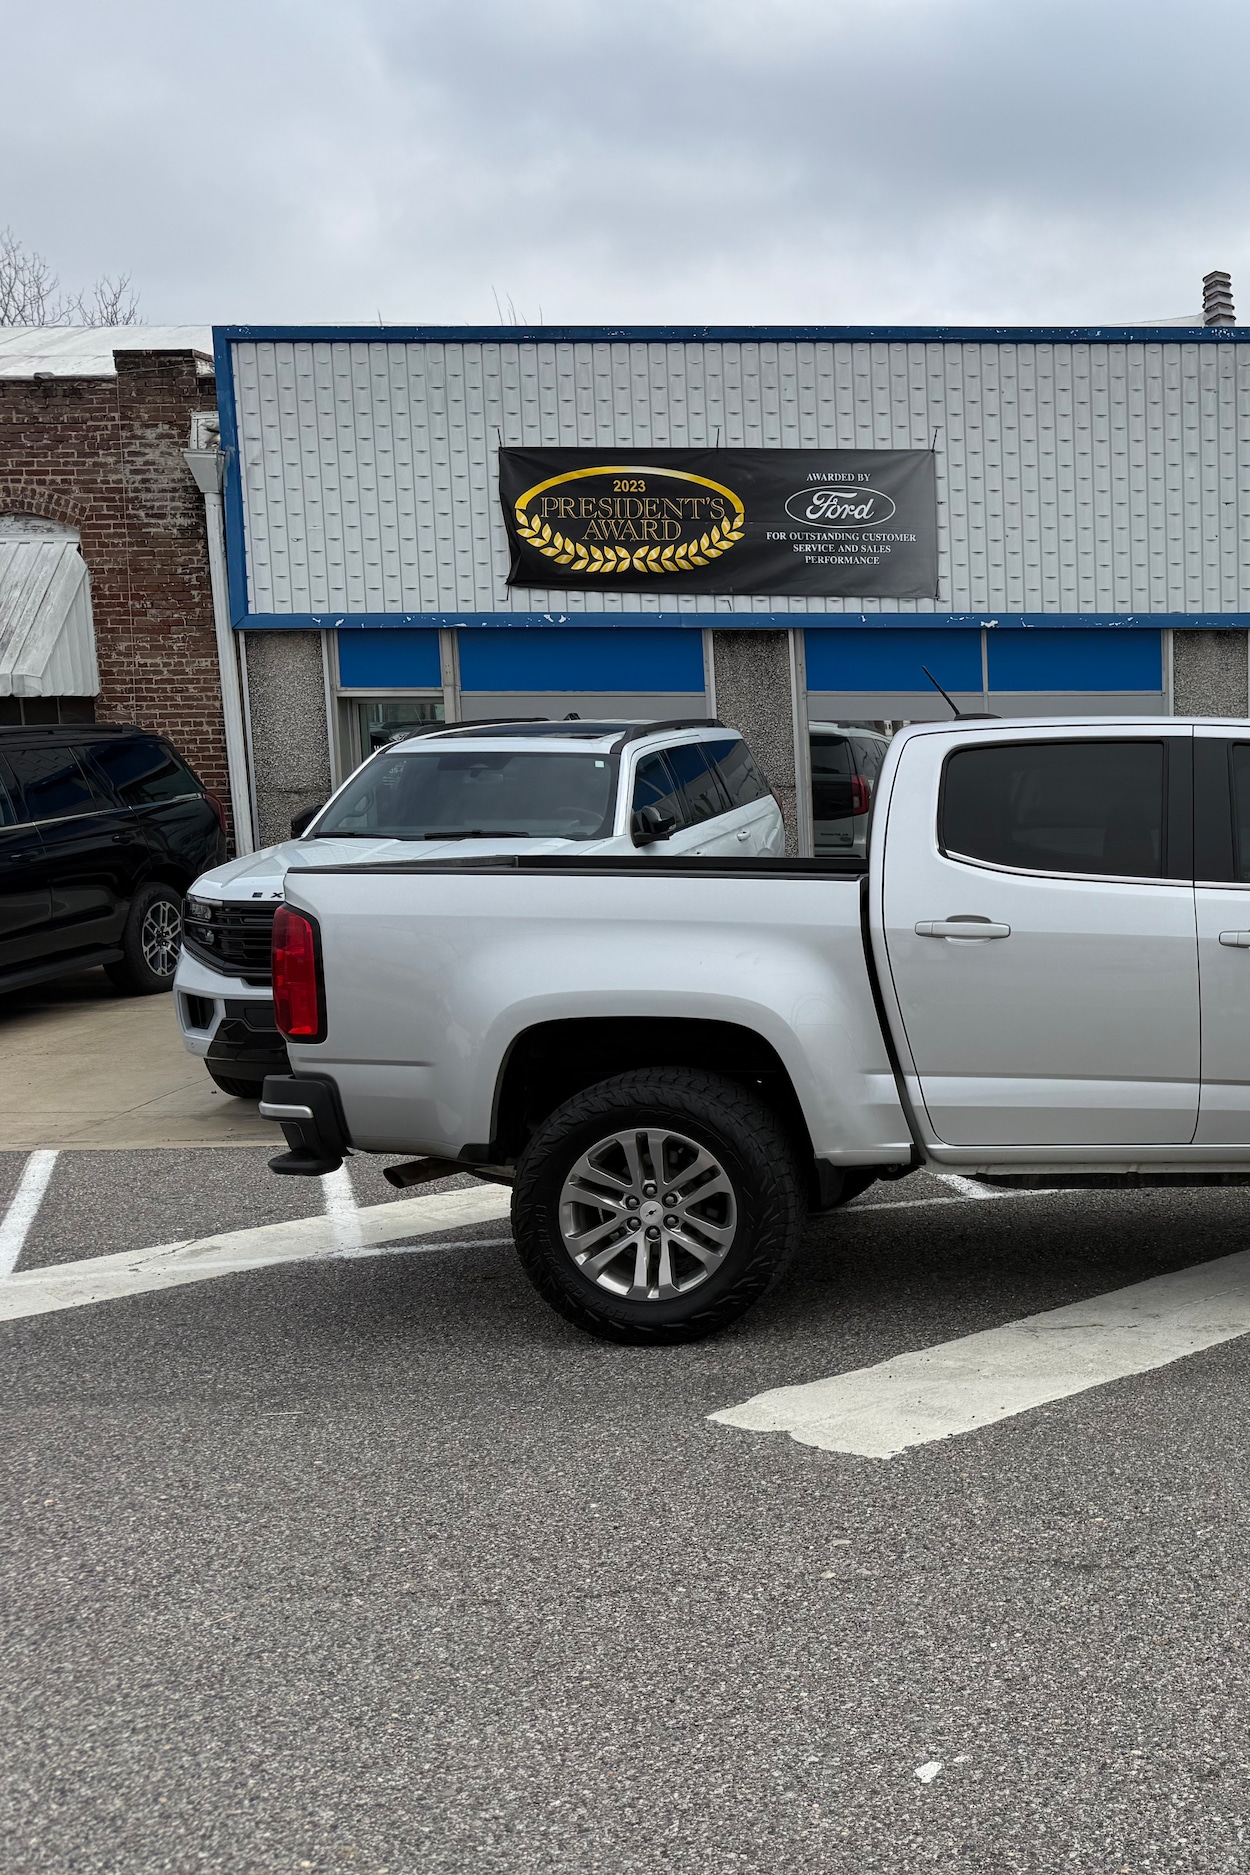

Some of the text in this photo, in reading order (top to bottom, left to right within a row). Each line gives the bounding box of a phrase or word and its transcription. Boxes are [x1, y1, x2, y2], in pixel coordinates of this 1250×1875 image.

[806, 473, 871, 482] AWARDED BY
[613, 479, 646, 492] 2023
[540, 497, 726, 520] PRESIDENT'S
[805, 490, 875, 520] Ford
[582, 519, 682, 542] AWARD
[766, 531, 917, 542] FOR OUTSTANDING CUSTOMER
[792, 543, 892, 553] SERVICE AND SALES
[805, 555, 880, 565] PERFORMANCE
